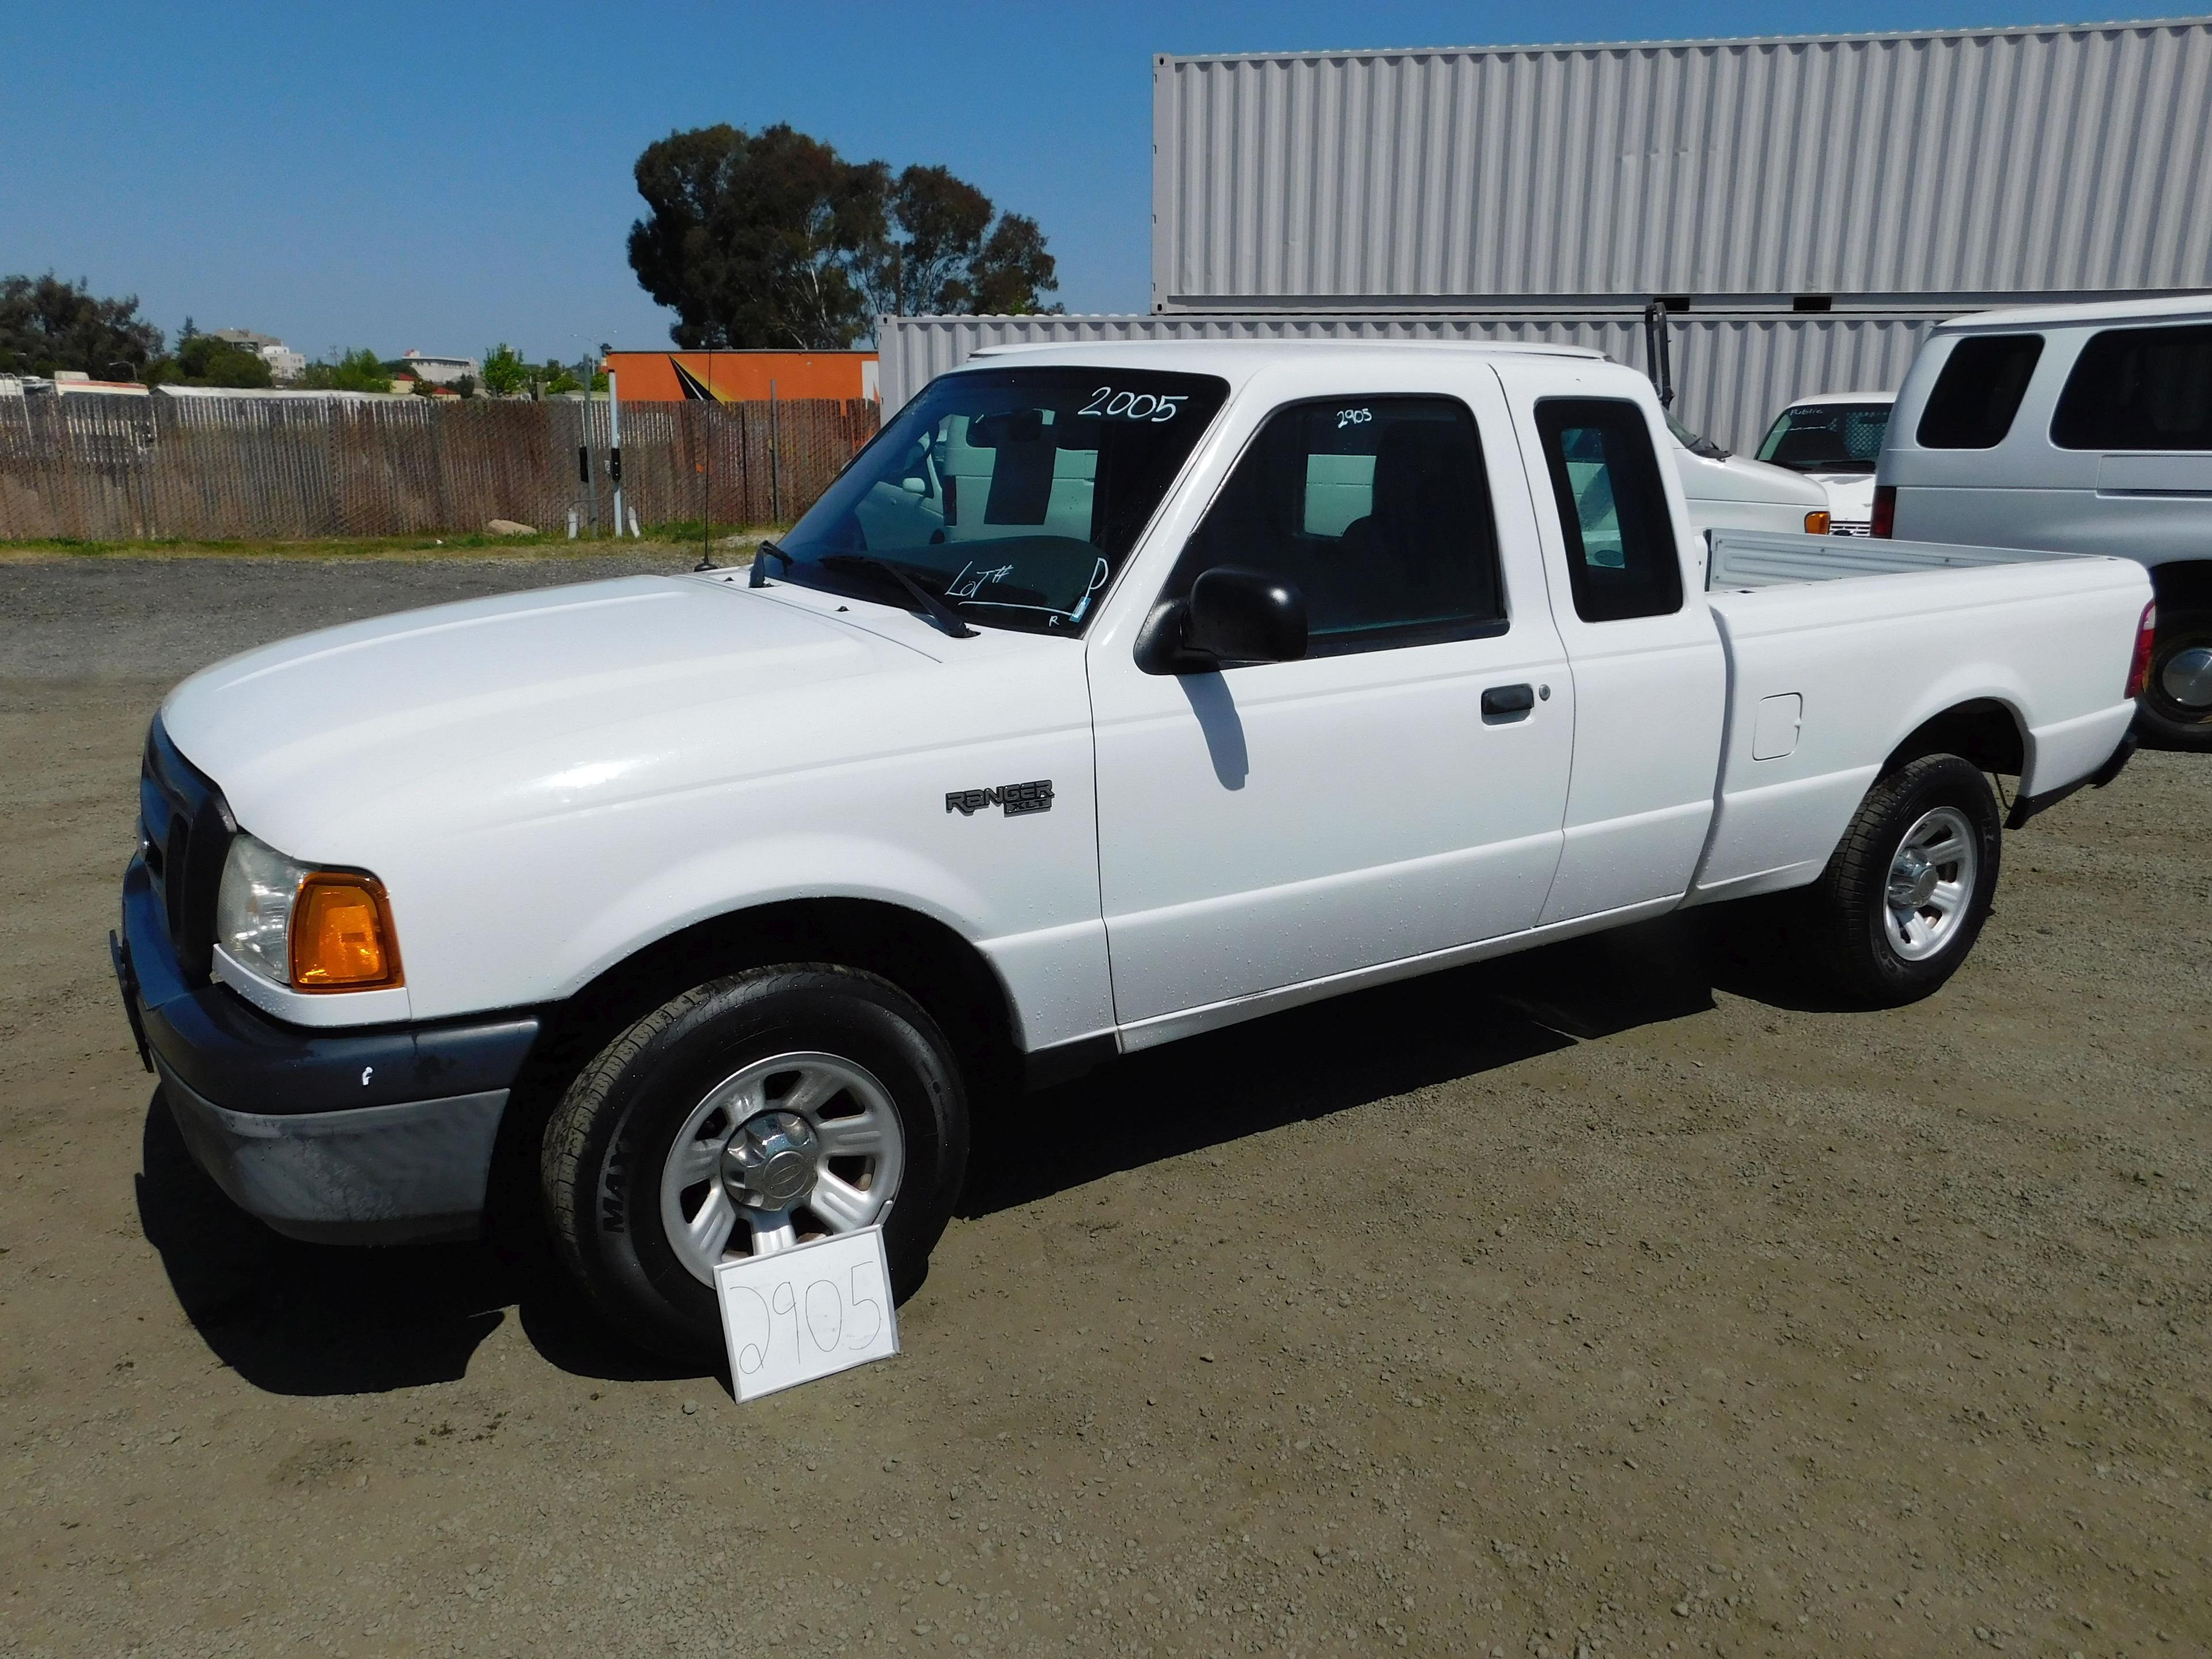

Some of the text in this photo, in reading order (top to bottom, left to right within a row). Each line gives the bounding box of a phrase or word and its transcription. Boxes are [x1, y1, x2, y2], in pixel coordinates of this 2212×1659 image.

[1077, 387, 1189, 422] 2005
[1336, 408, 1372, 429] 2905
[1048, 615, 1060, 627] R
[730, 1261, 881, 1374] 2905
